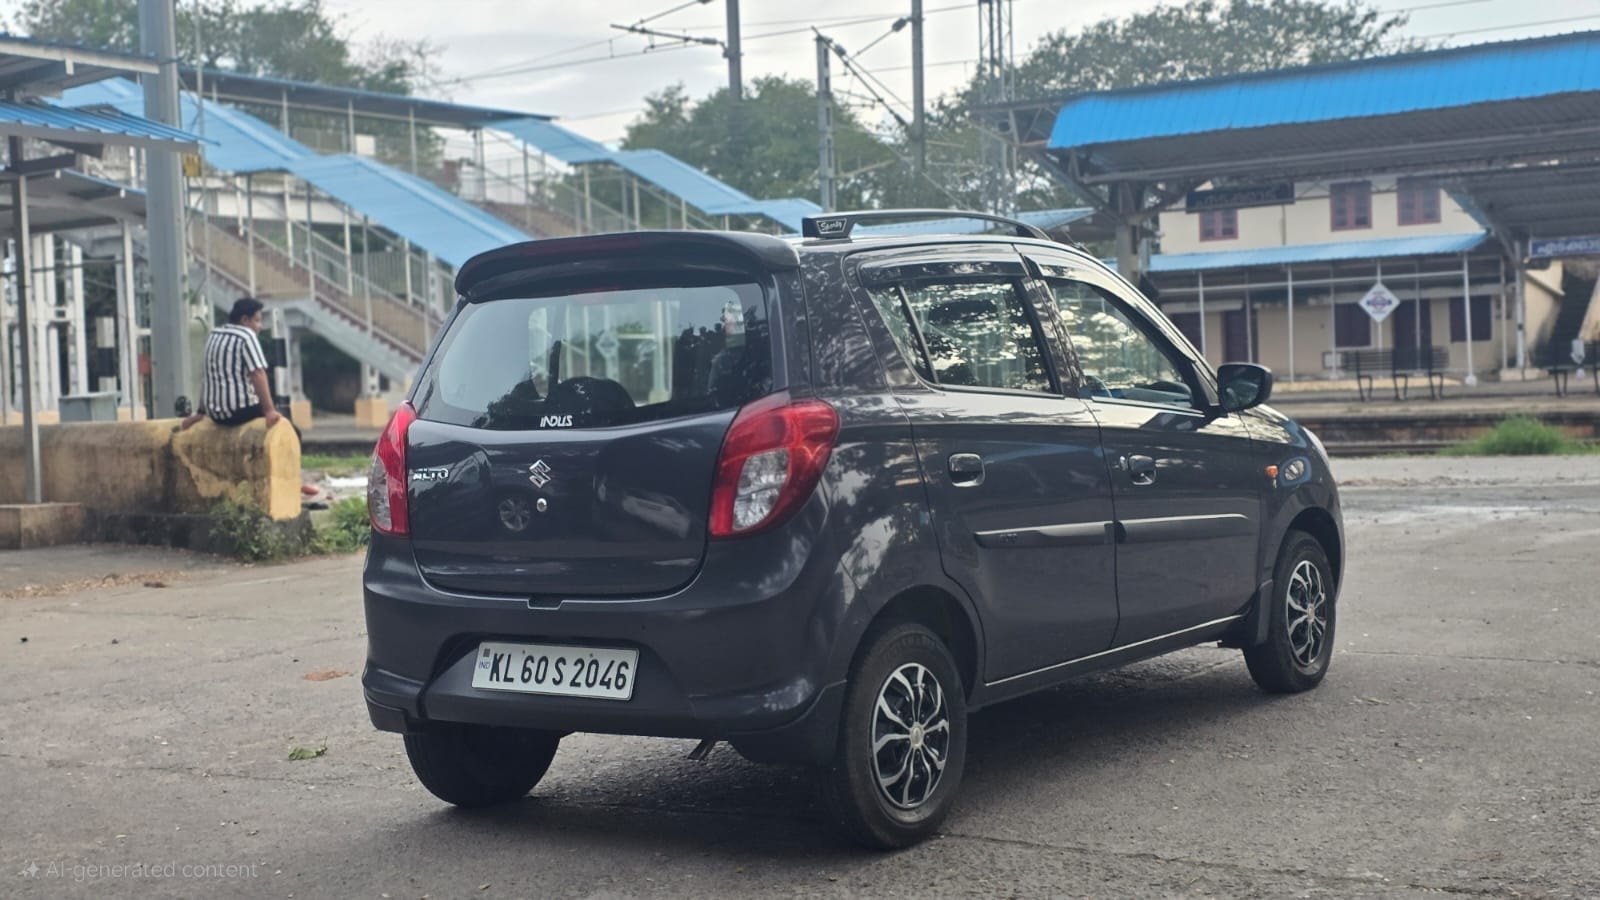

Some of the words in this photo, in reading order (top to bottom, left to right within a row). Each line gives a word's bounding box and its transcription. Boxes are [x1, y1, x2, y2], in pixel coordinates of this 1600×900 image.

[540, 415, 572, 427] INDUS
[412, 468, 448, 480] ALTO
[478, 660, 491, 670] IND
[489, 653, 514, 683] KL
[520, 655, 549, 684] 60
[552, 657, 567, 686] S
[569, 658, 630, 690] 2046
